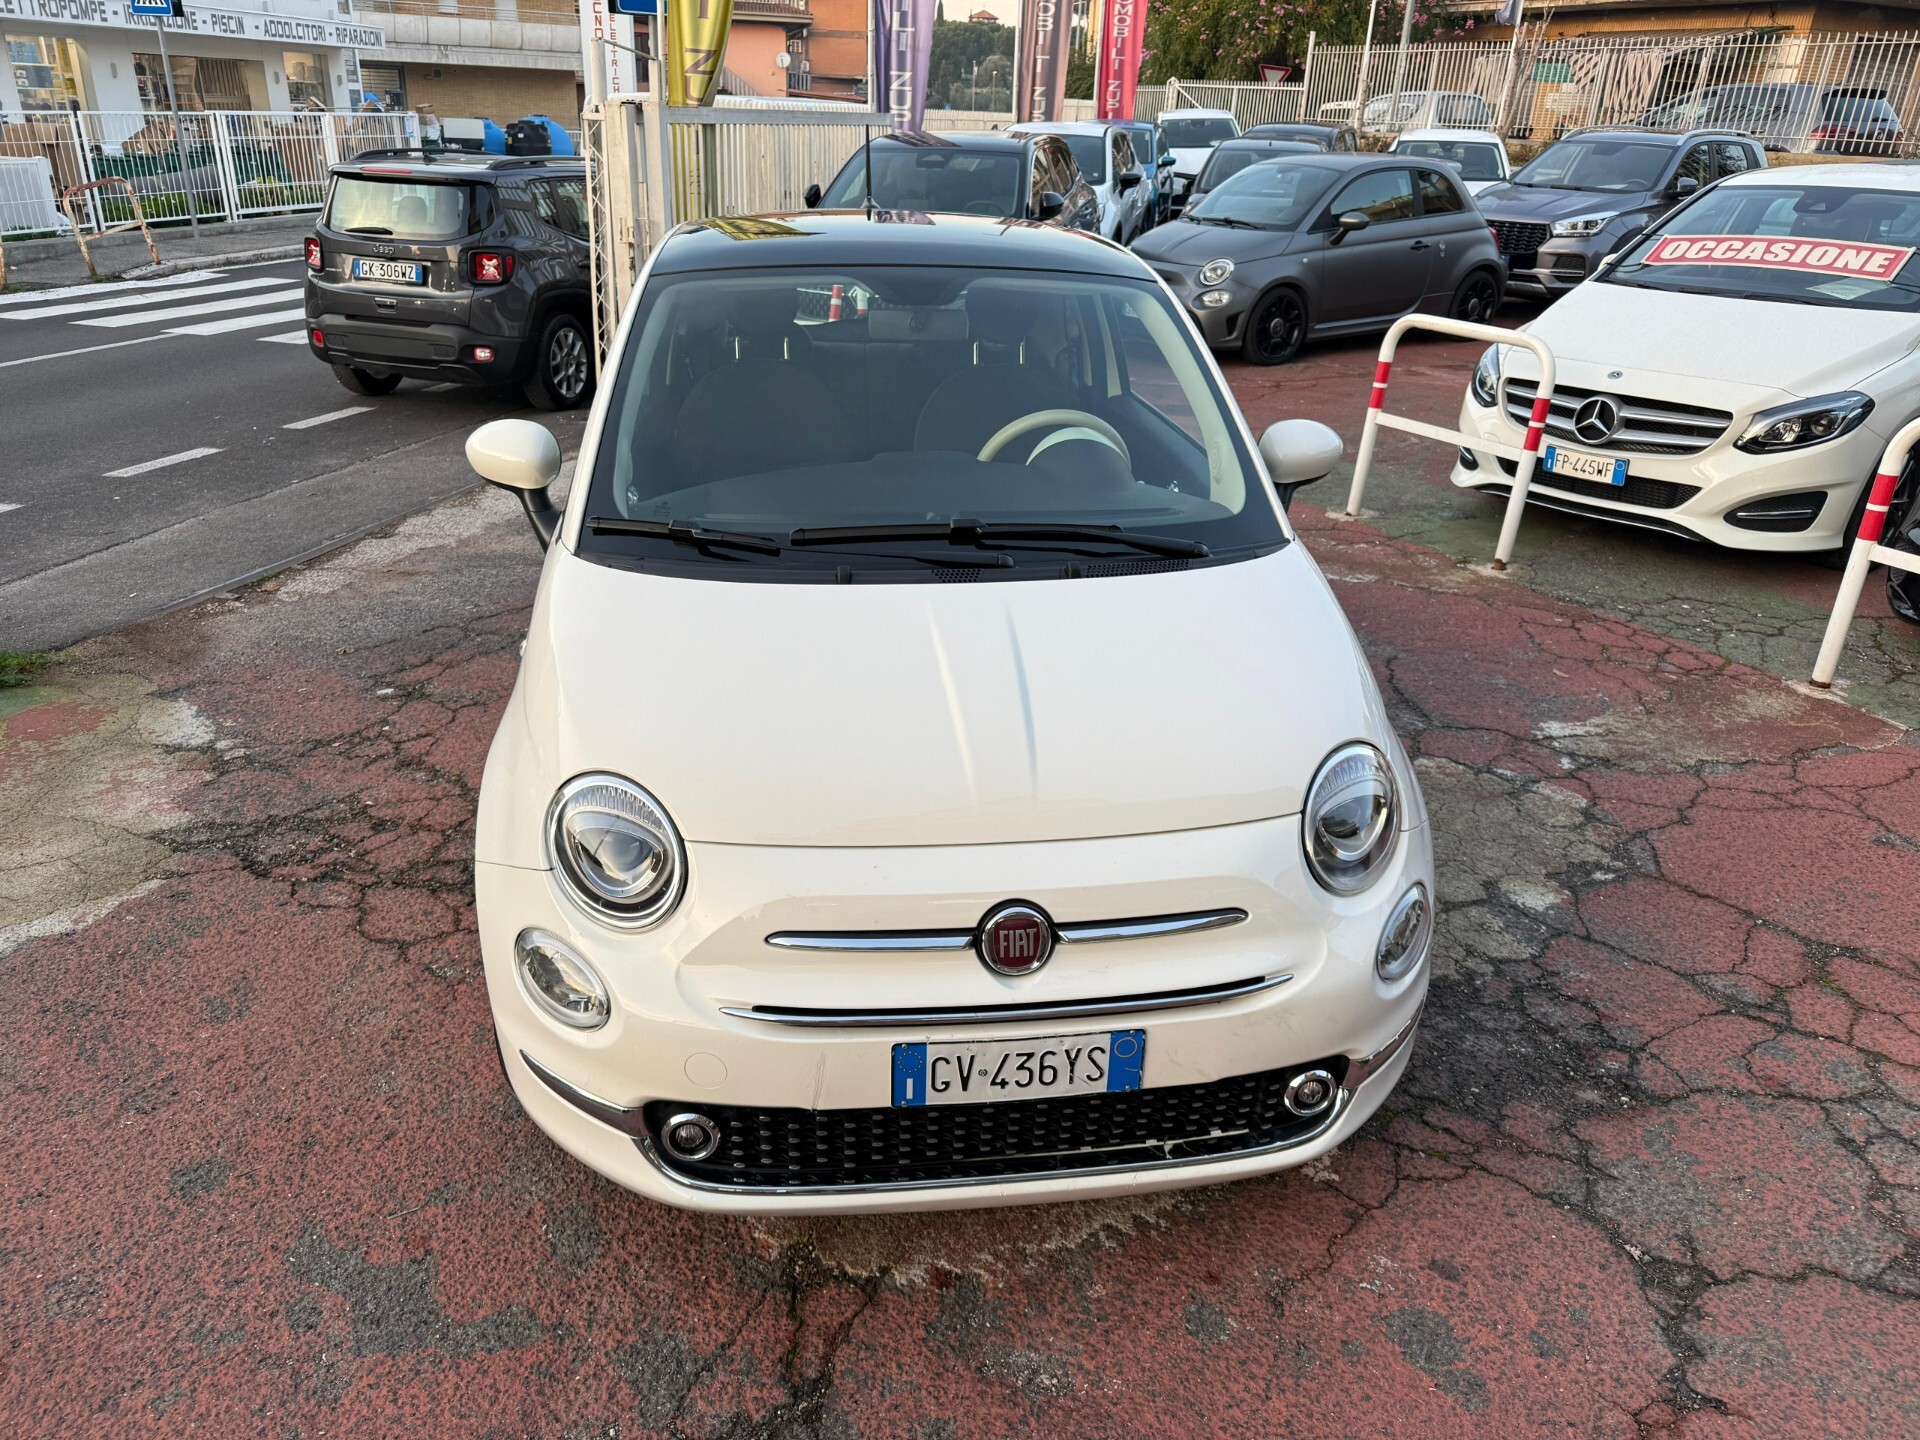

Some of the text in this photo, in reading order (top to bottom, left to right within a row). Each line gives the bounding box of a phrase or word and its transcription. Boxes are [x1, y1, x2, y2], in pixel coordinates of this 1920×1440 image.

[211, 13, 245, 35] PISCIN
[264, 19, 327, 42] ADDOLCITORI
[335, 26, 383, 47] RIPARAZIONI
[592, 0, 604, 39] CNO
[1035, 0, 1055, 73] OBILI
[684, 47, 717, 107] ZU
[1659, 240, 1896, 274] OCCASIONE
[999, 927, 1037, 958] FIAT
